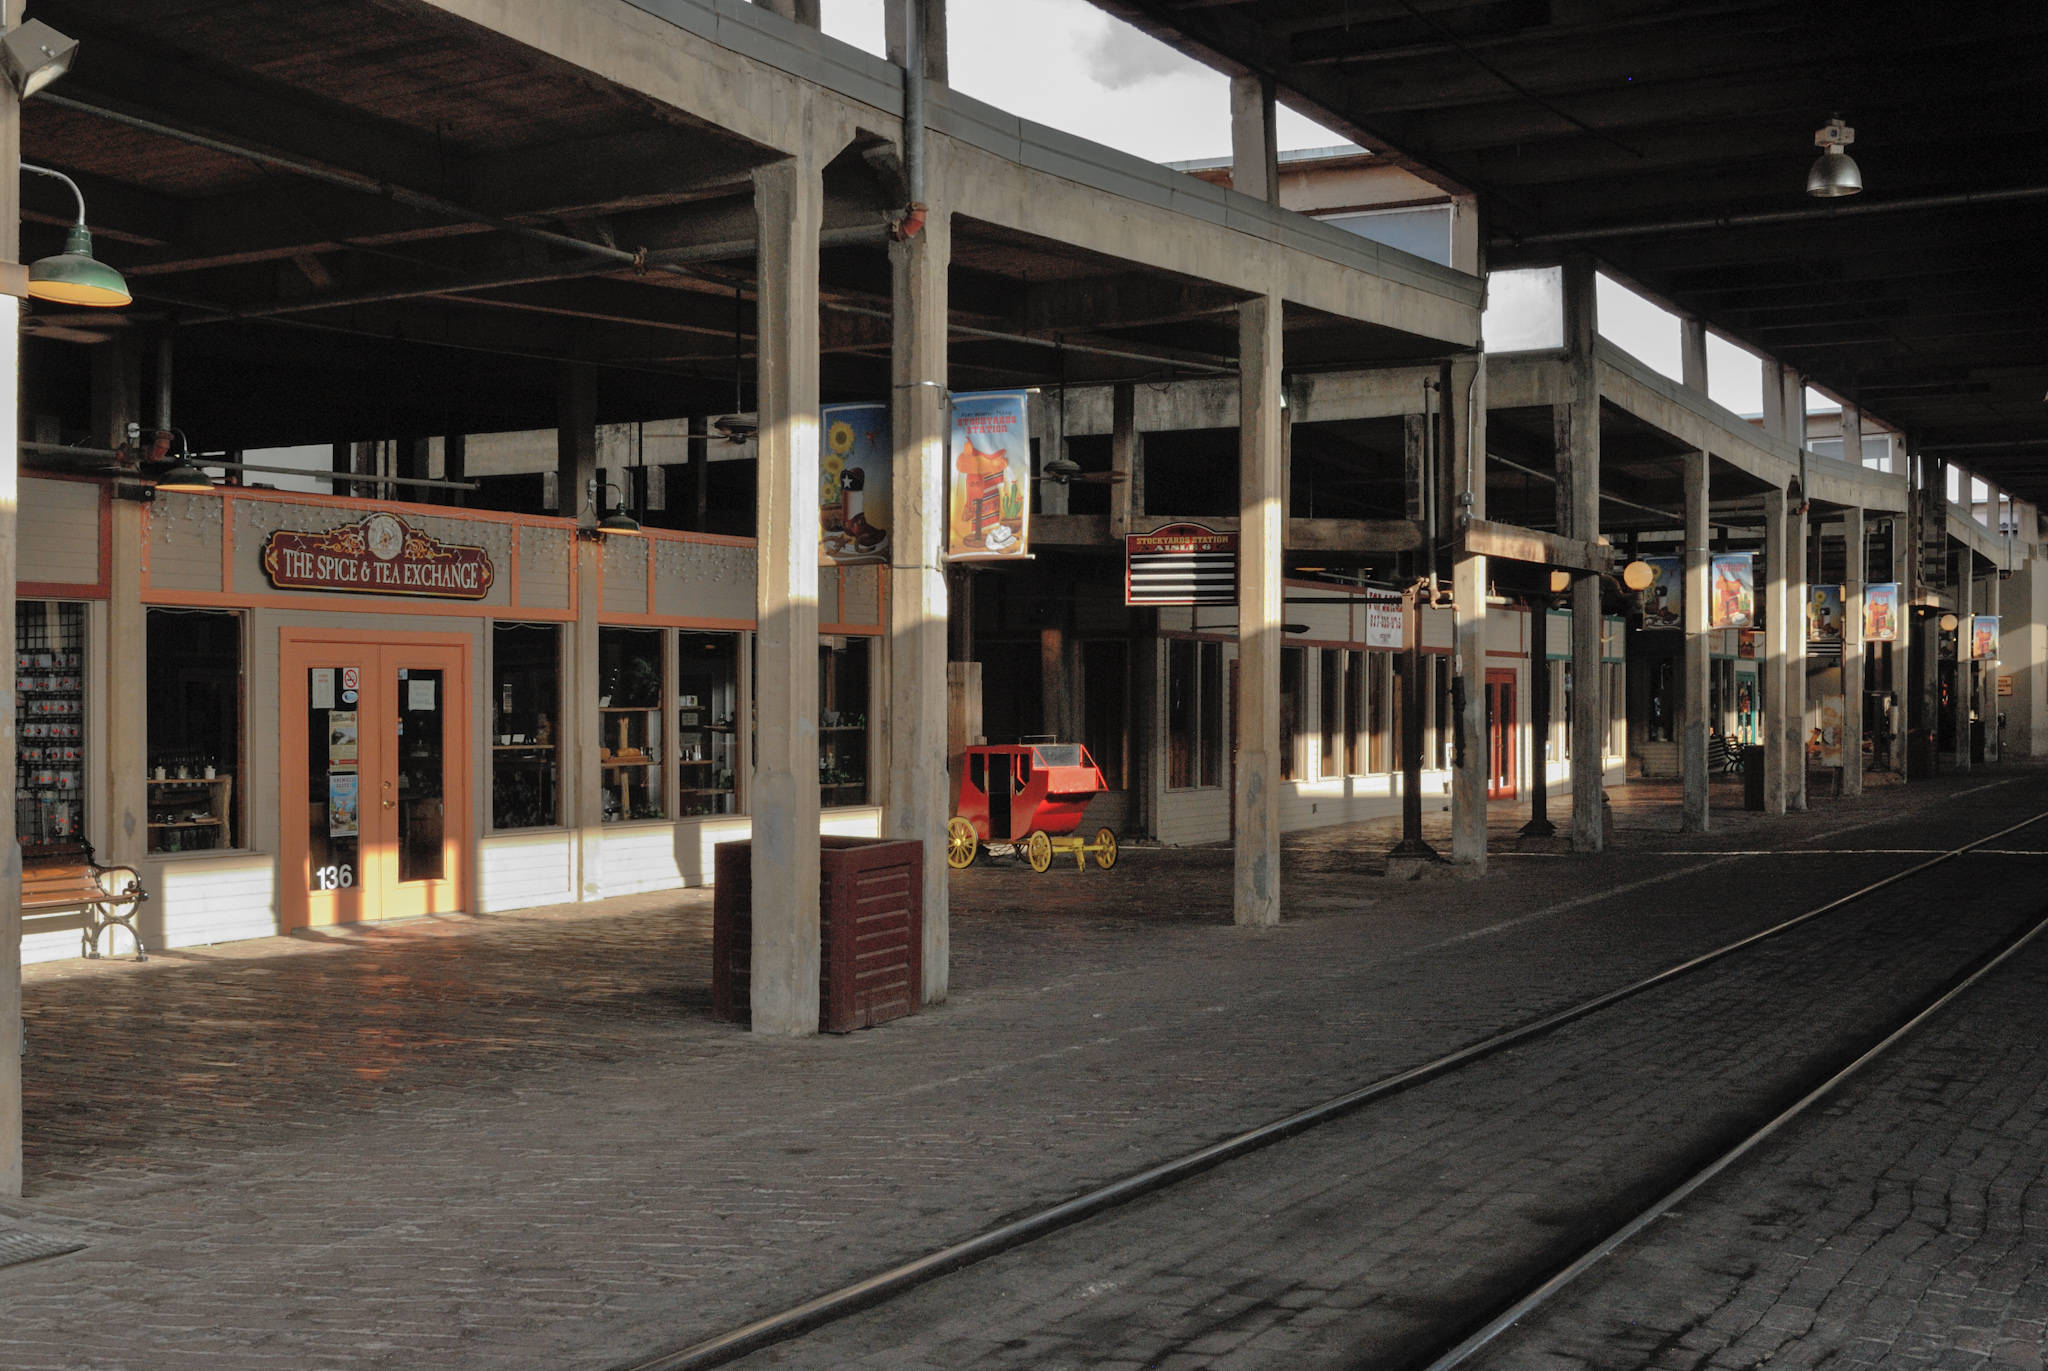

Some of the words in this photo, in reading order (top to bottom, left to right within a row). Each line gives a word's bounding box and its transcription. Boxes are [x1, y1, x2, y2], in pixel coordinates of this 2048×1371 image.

[957, 416, 1016, 426] STOCKYARDS
[966, 424, 1008, 434] STATION
[1136, 536, 1191, 545] STOCKYARDS
[1192, 535, 1229, 544] STATION
[282, 548, 313, 580] THE
[317, 556, 358, 582] SPICE
[360, 561, 371, 582] &
[373, 561, 401, 585] TEA
[403, 563, 478, 589] EXCHANGE
[316, 863, 353, 890] 136
